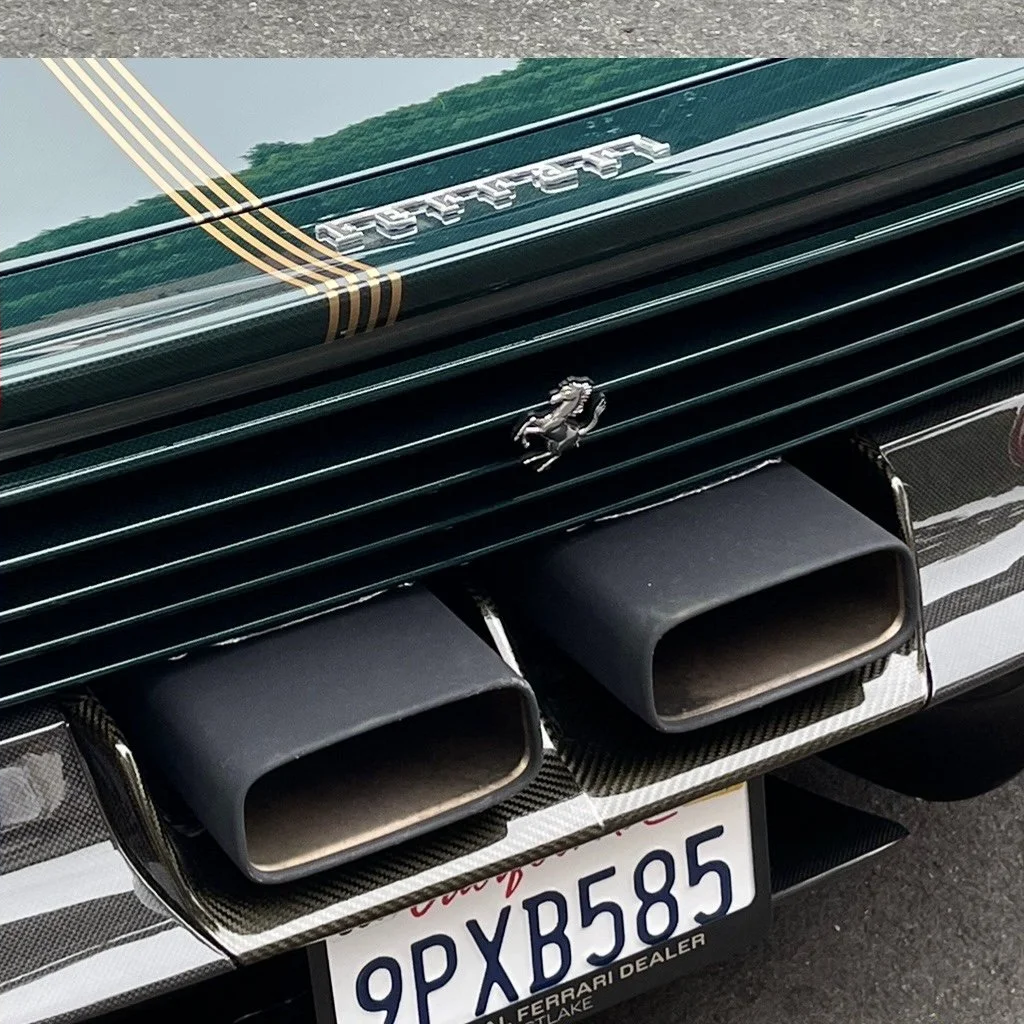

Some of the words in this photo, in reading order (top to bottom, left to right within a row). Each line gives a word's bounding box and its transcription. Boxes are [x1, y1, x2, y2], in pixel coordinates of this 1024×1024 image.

[355, 825, 733, 1024] 9PXB585
[517, 970, 614, 1023] FERRARI
[619, 932, 706, 980] DEALER
